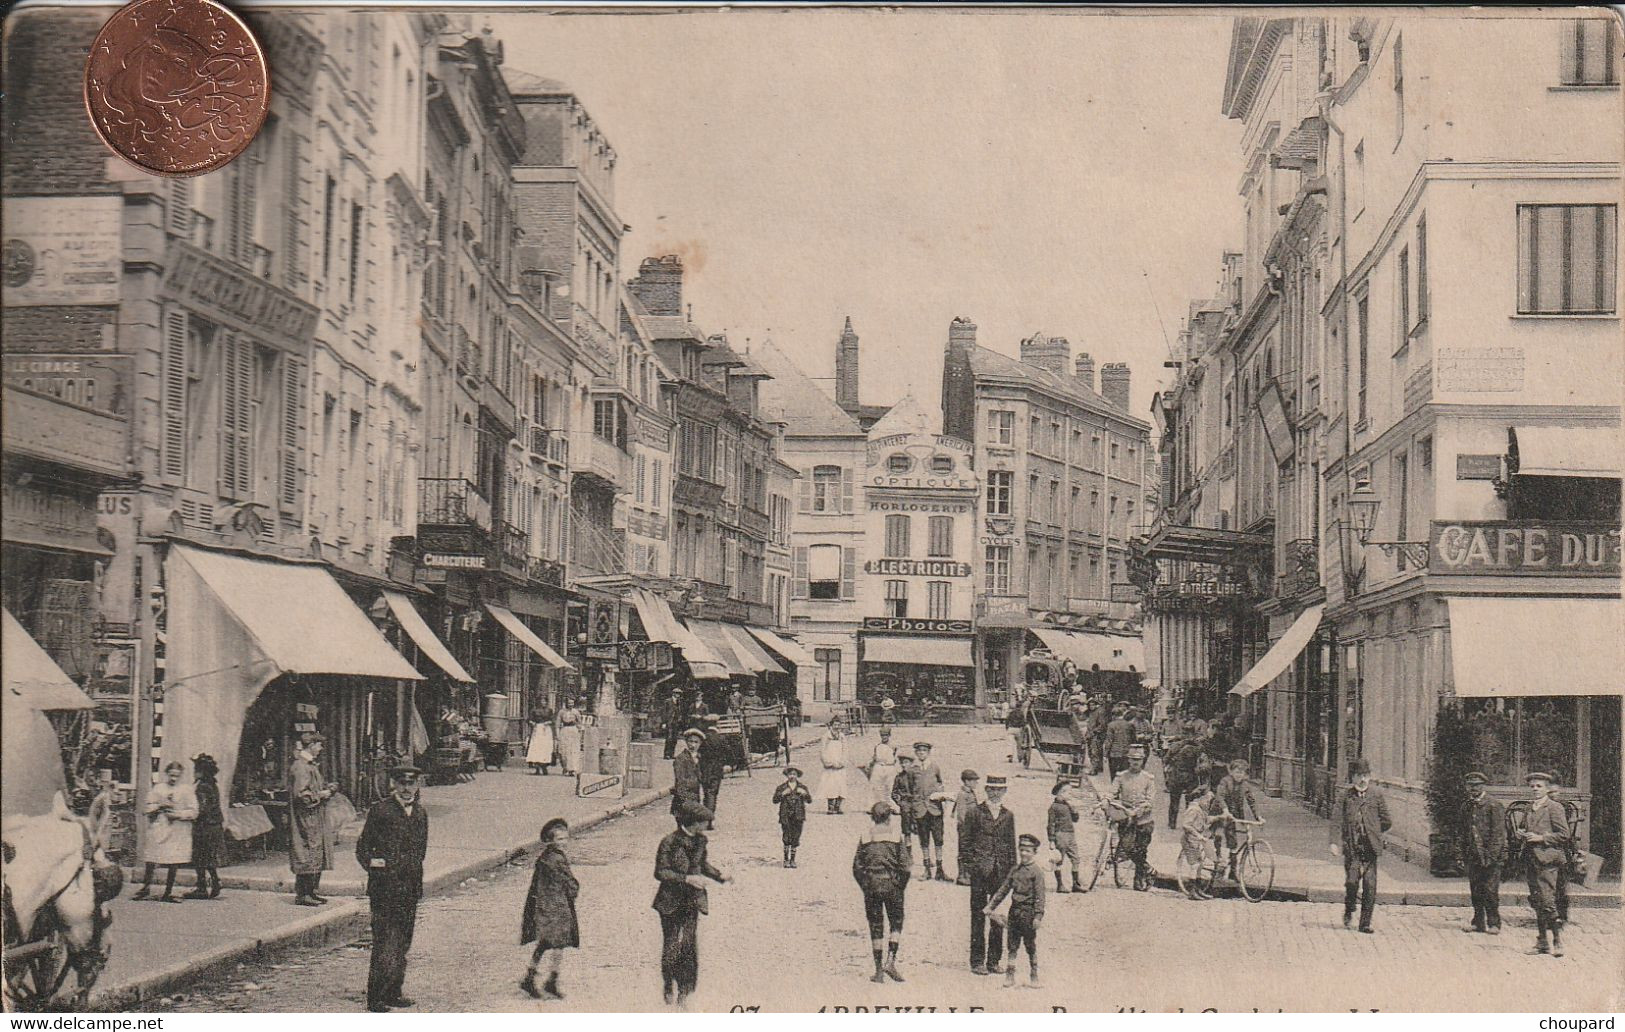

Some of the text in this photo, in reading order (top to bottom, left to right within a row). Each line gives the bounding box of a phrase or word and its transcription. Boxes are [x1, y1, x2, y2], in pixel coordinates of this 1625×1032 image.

[873, 476, 969, 488] OPTIQUE
[870, 502, 968, 513] HORLOGERIE
[980, 536, 1021, 547] CYCLES
[1560, 534, 1605, 567] DU
[1216, 583, 1242, 595] LIBRE
[888, 619, 948, 631] Photo
